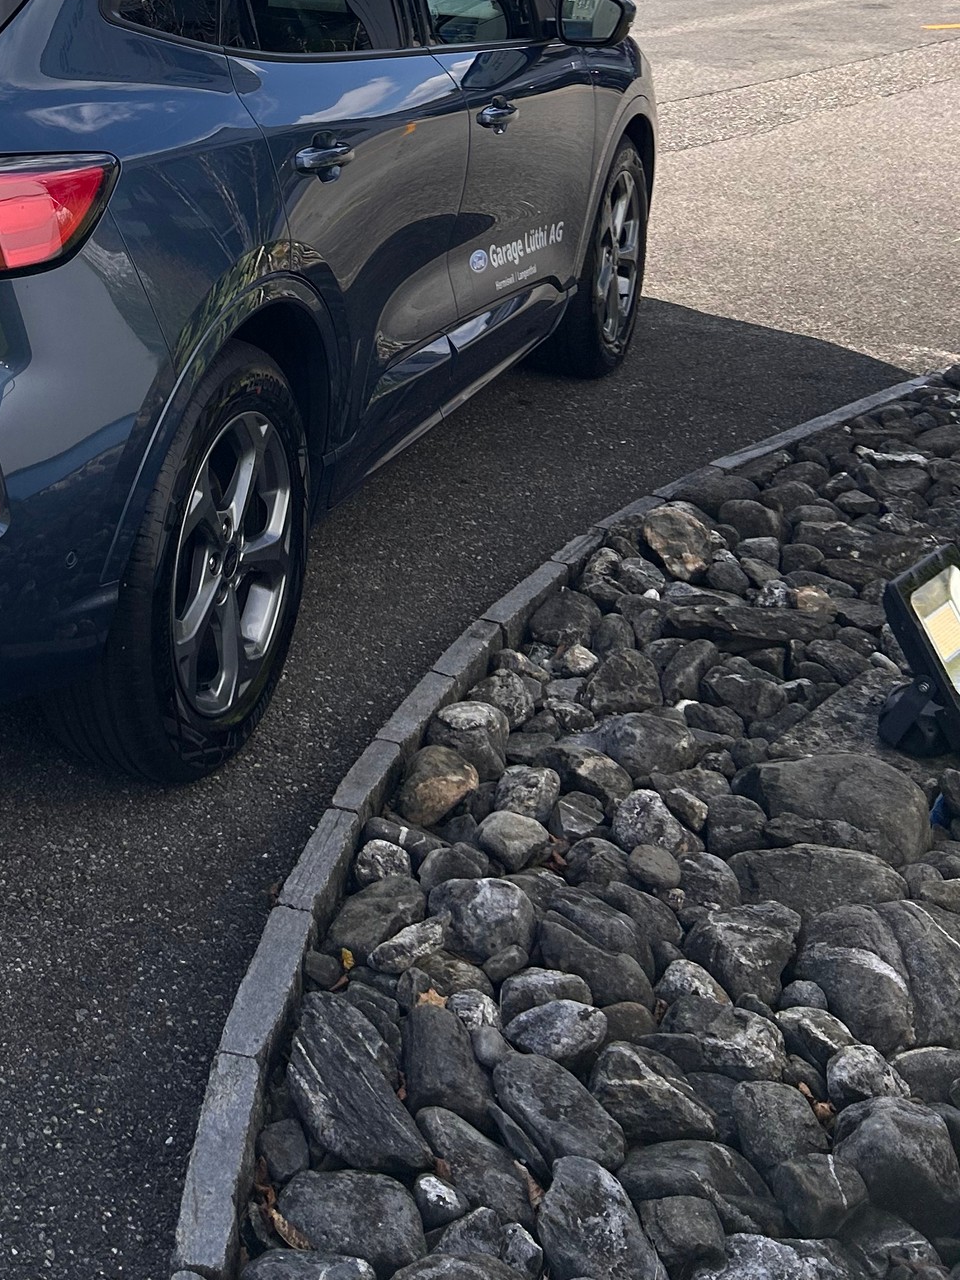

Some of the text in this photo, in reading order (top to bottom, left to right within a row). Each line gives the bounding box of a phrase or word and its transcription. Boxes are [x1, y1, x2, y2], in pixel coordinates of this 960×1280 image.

[489, 239, 524, 269] Garage
[524, 224, 548, 254] Lüthi
[549, 221, 564, 245] AG
